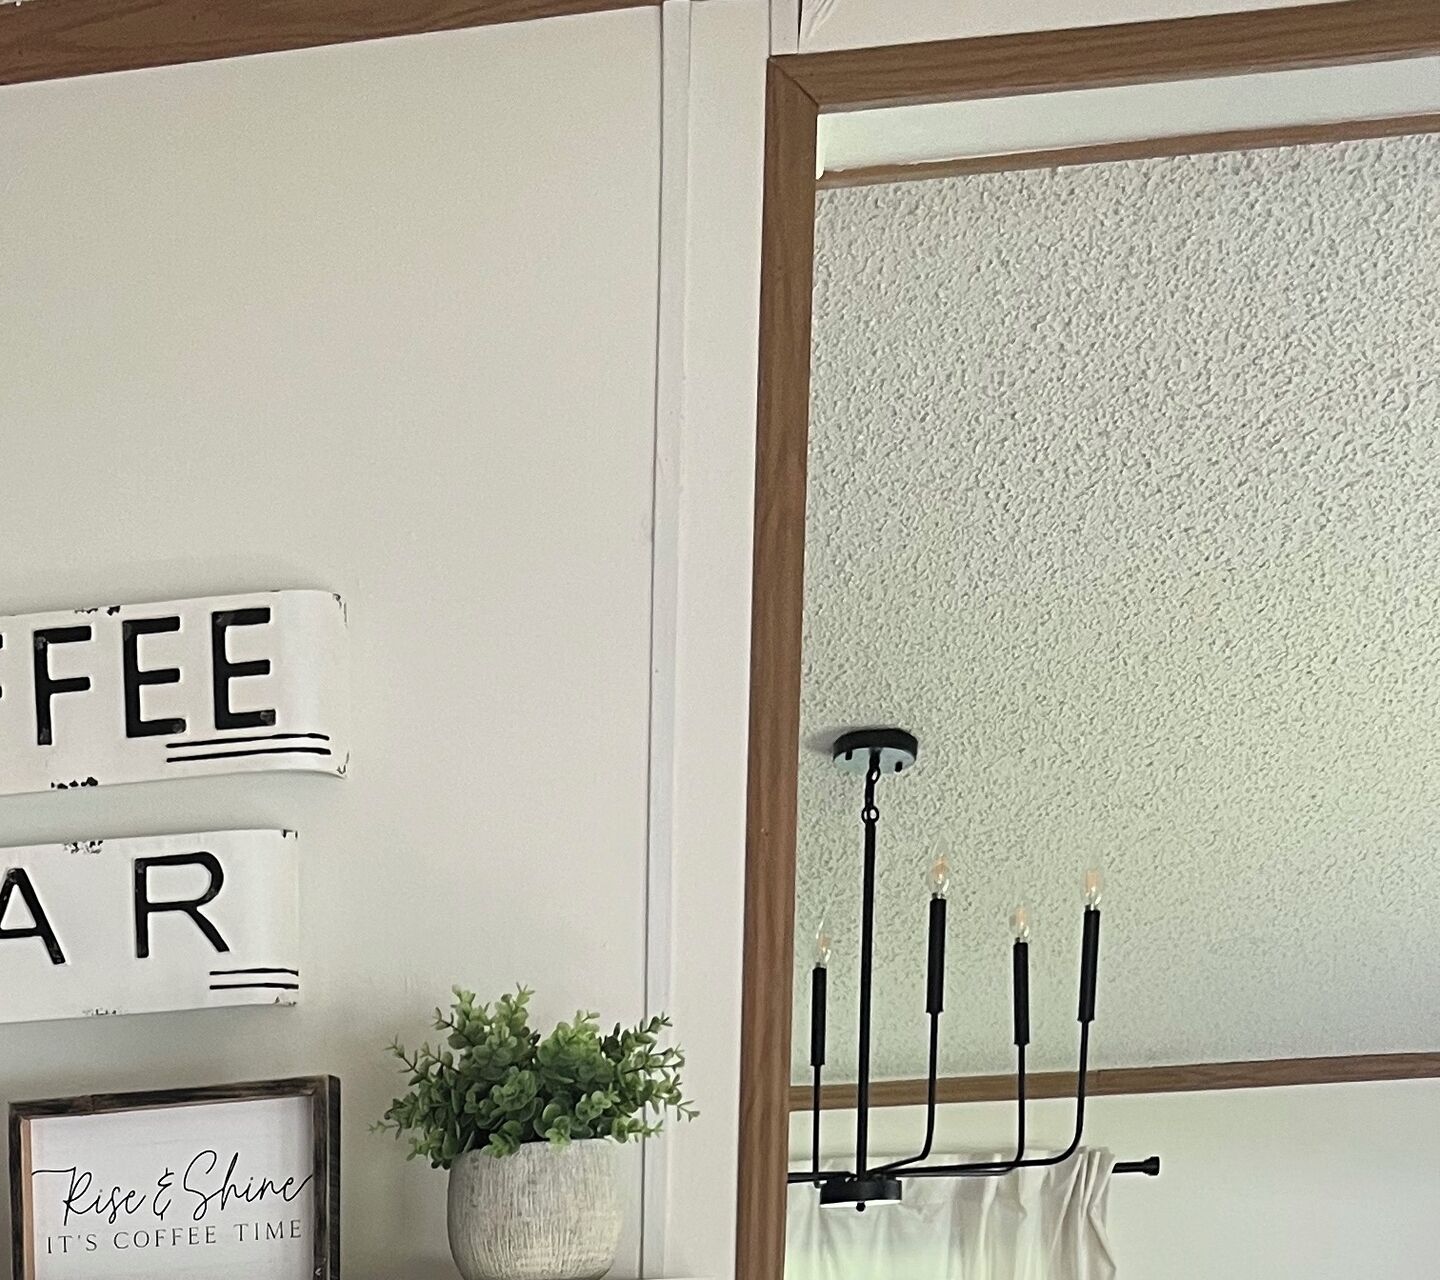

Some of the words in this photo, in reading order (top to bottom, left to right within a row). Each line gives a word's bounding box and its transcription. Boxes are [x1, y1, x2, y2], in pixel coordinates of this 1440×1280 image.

[31, 1166, 147, 1226] Rise
[152, 1166, 176, 1221] &
[183, 1149, 314, 1221] Shine
[46, 1233, 98, 1254] IT'S
[113, 1224, 217, 1250] COFFEE
[233, 1218, 303, 1242] TIME
